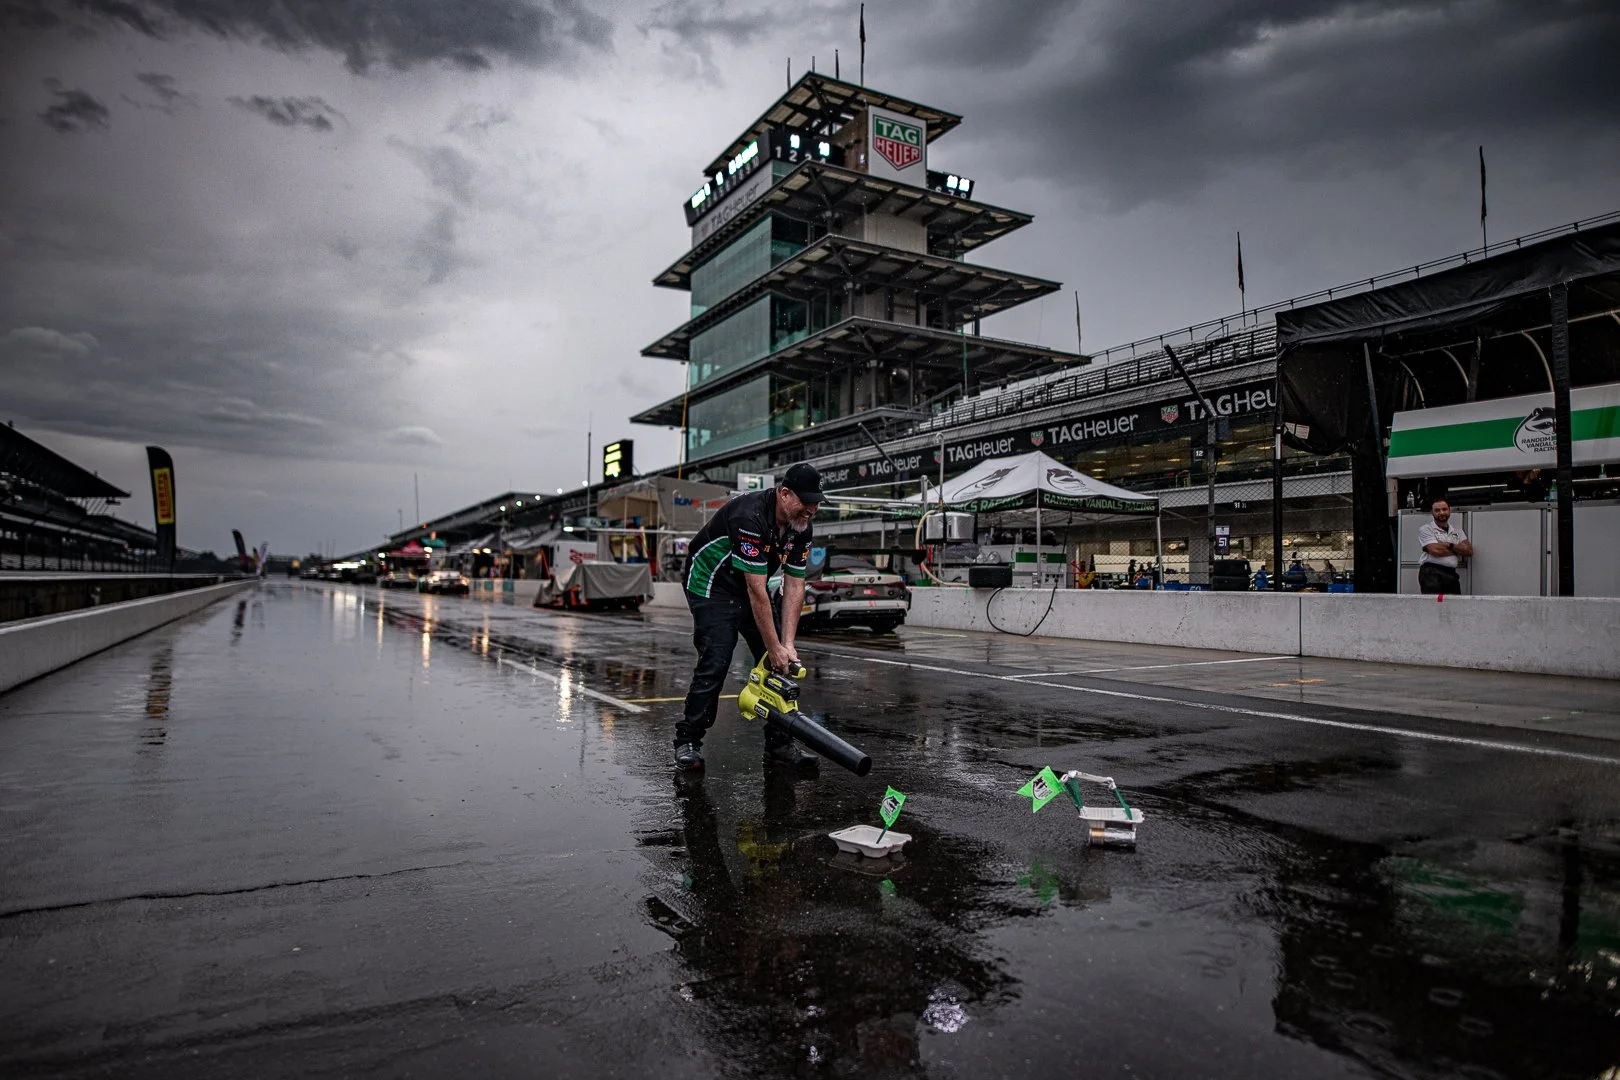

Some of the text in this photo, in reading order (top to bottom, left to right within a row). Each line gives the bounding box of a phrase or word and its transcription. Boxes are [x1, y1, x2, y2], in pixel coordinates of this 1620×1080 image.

[878, 120, 918, 144] TAG
[775, 146, 782, 159] 1
[788, 150, 798, 163] 2
[876, 138, 920, 166] HEUER
[1048, 413, 1139, 445] TAGHeuer
[1521, 436, 1551, 444] RANDOM
[748, 475, 764, 489] 51
[820, 468, 850, 485] Heuer
[1044, 493, 1084, 507] RANDOM
[1085, 496, 1123, 510] VANDALS
